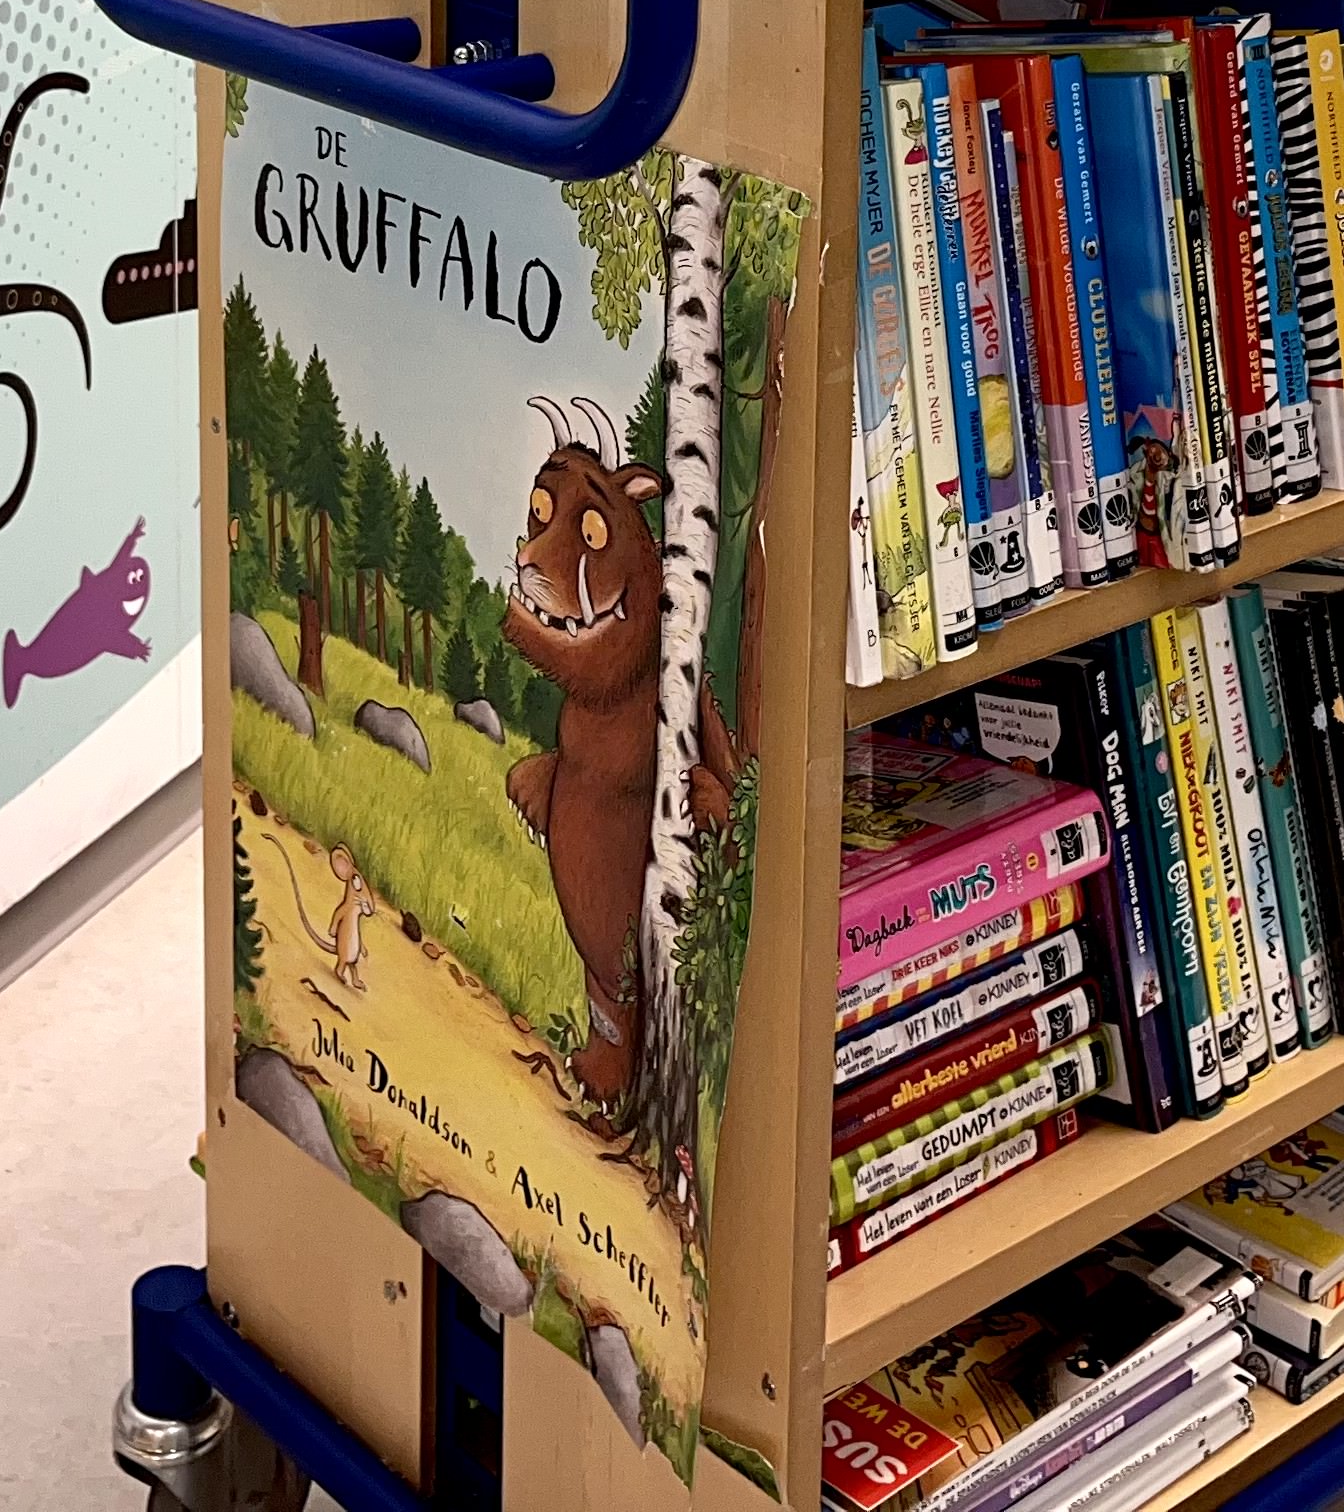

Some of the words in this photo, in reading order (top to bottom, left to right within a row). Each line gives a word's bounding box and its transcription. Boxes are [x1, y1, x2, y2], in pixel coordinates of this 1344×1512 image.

[1226, 50, 1238, 100] Gerard
[962, 99, 972, 132] Janet
[1071, 82, 1084, 133] Gerard
[1230, 103, 1240, 130] van
[315, 126, 348, 168] DE
[1077, 137, 1087, 165] van
[1232, 134, 1245, 185] Gemert
[1325, 90, 1342, 181] NORTHFIELD
[908, 175, 919, 198] De
[1080, 170, 1094, 224] Gemert
[910, 201, 922, 238] hele
[961, 188, 994, 288] MUNKEL
[254, 163, 562, 344] GRUFFALO
[912, 244, 926, 279] erge
[917, 285, 930, 322] Ellie
[955, 280, 968, 319] Gaan
[1238, 230, 1258, 343] GEVAARLIJK
[922, 327, 933, 347] en
[959, 322, 972, 356] voor
[972, 294, 1000, 361] TROG
[1086, 277, 1117, 426] CLUBLIEFDE
[924, 352, 936, 384] nare
[960, 360, 975, 397] goud
[1248, 349, 1261, 394] SPEL
[927, 396, 942, 445] Nellie
[928, 863, 997, 922] MUTS
[891, 961, 912, 982] DRIE
[913, 951, 937, 975] KEER
[938, 939, 960, 965] NIKS
[974, 912, 1020, 942] KINNEY
[890, 1055, 969, 1109] allerbeste
[971, 1028, 1018, 1072] vriend
[922, 1107, 997, 1161] GEDUMPT
[311, 1018, 355, 1073] Julia
[365, 1049, 474, 1159] Donaldson
[484, 1150, 498, 1178] &
[511, 1166, 564, 1227] Axel
[577, 1211, 671, 1329] Scheffler
[863, 1218, 885, 1245] Het
[886, 1201, 913, 1232] leven
[913, 1193, 935, 1216] van
[935, 1185, 953, 1205] een
[953, 1166, 983, 1192] Loser
[993, 1134, 1035, 1169] KINNEY
